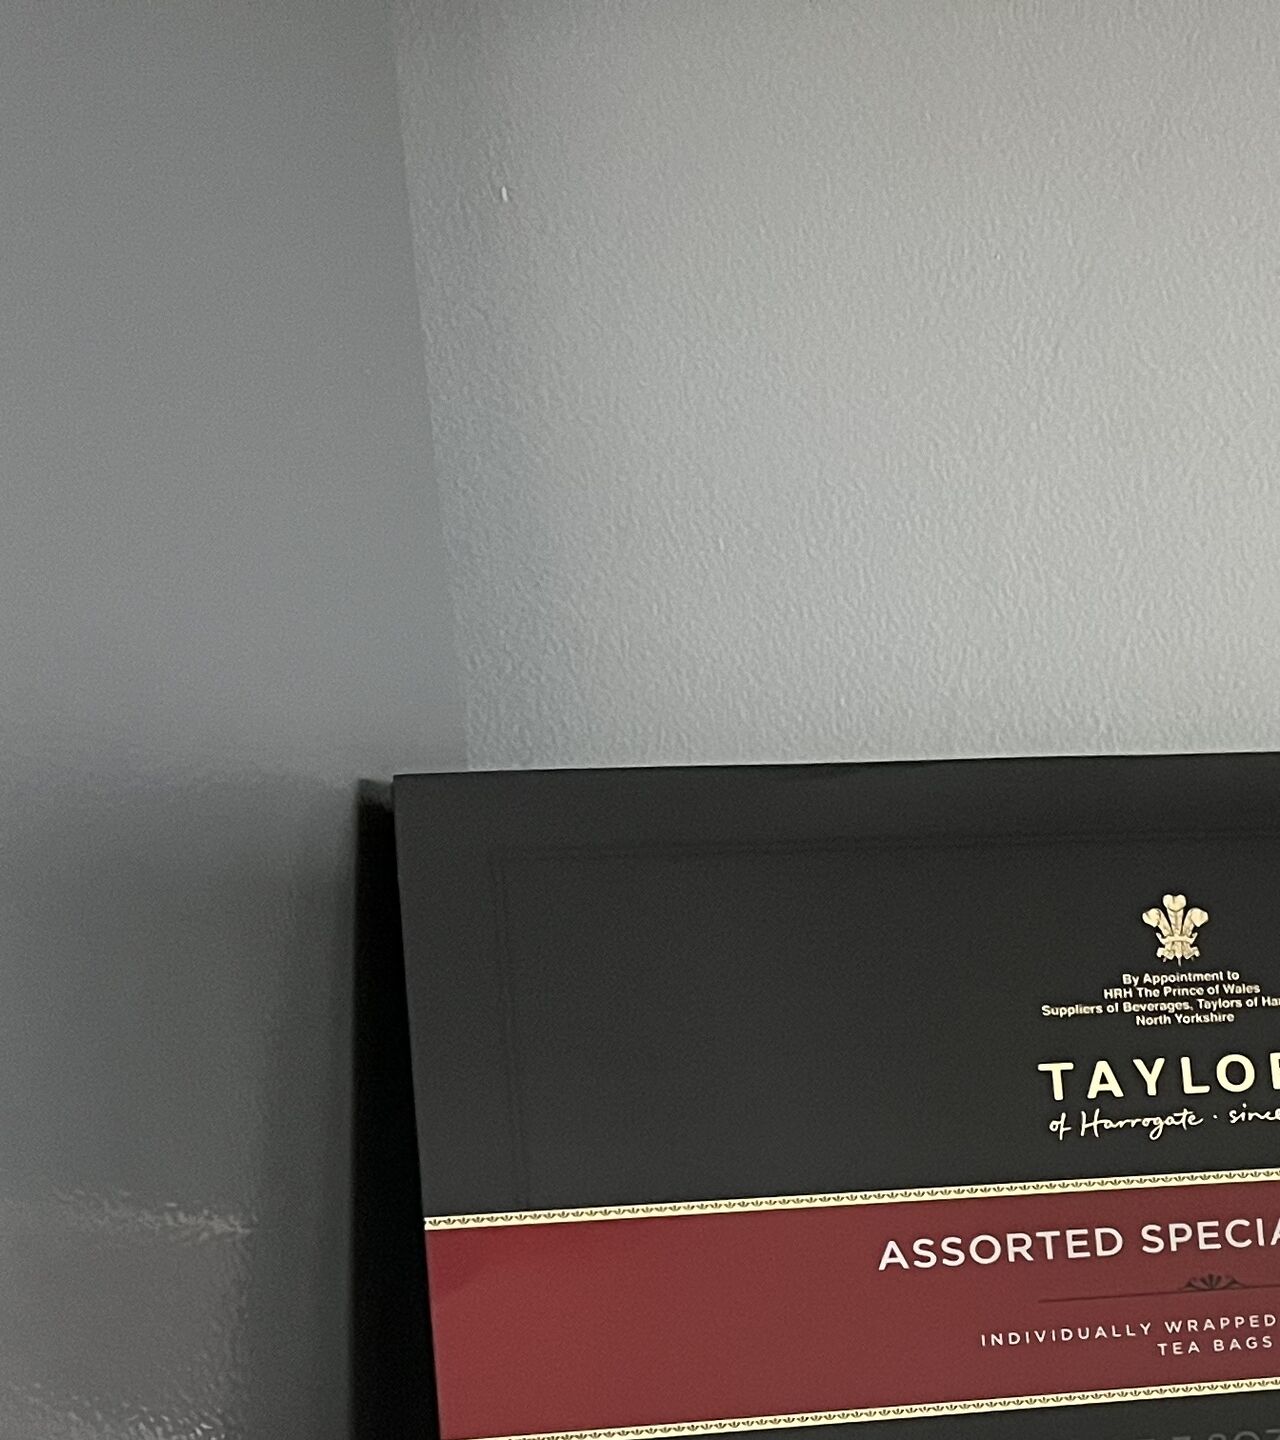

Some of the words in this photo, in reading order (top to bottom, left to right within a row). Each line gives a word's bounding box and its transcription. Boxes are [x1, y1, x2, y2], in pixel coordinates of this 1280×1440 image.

[1122, 974, 1139, 987] By
[1143, 971, 1223, 986] Appointment
[1226, 971, 1240, 982] to
[1103, 987, 1133, 1000] HRH
[1137, 986, 1160, 998] The
[1163, 985, 1204, 997] Prince
[1207, 984, 1220, 995] of
[1222, 982, 1261, 994] Wales
[1041, 1003, 1103, 1018] Suppliers
[1106, 1002, 1119, 1013] of
[1196, 998, 1243, 1012] Taylors
[1245, 996, 1259, 1008] of
[1135, 1014, 1171, 1026] North
[1174, 1012, 1235, 1025] Yorkshire
[1048, 1112, 1072, 1141] of
[1080, 1107, 1204, 1141] Harrogate
[878, 1225, 1125, 1271] ASSORTED
[980, 1322, 1153, 1348] INDIVIDUALLY
[1164, 1313, 1277, 1336] WRAPPED
[1157, 1341, 1201, 1357] TEA
[1213, 1335, 1274, 1353] BAGS
